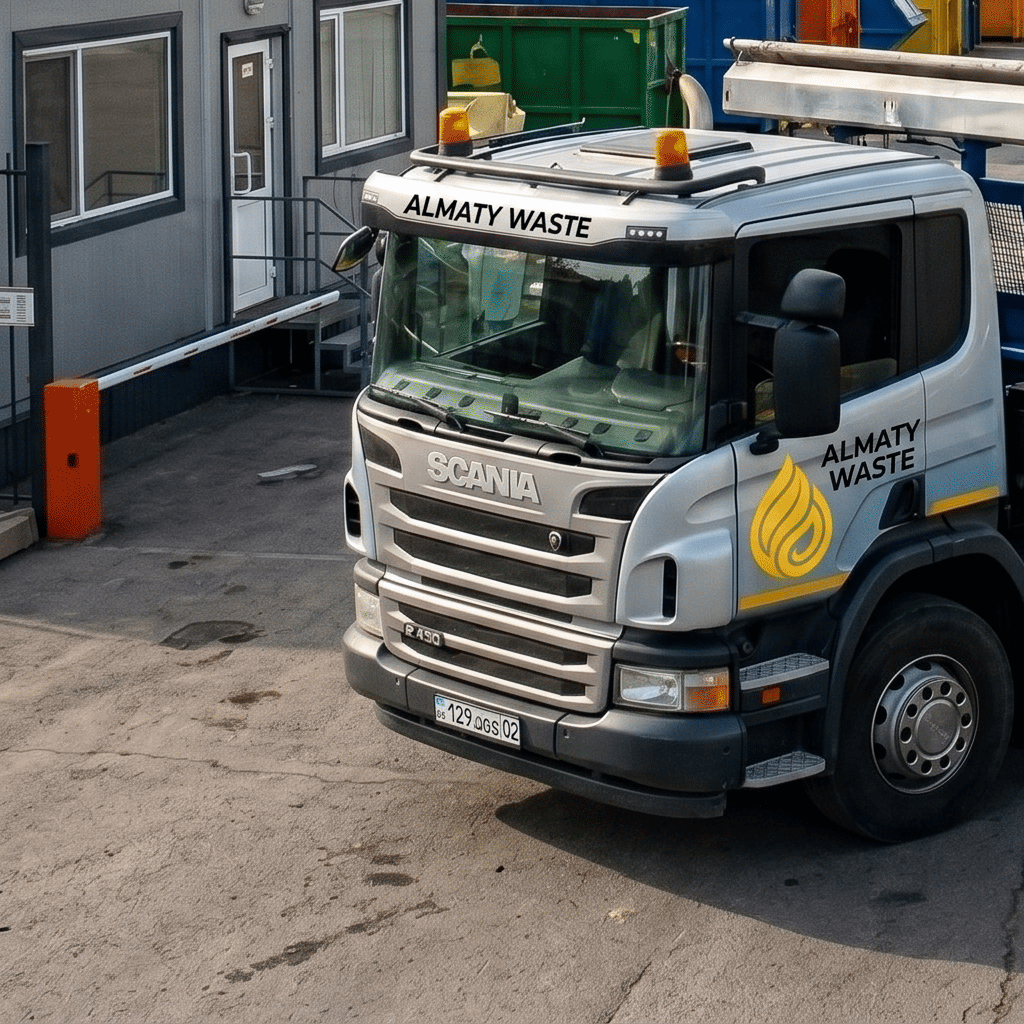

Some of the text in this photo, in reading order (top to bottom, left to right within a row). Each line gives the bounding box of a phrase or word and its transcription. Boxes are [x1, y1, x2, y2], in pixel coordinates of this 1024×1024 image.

[403, 194, 593, 239] ALMATY WASTE
[821, 418, 921, 468] ALMATY
[427, 451, 542, 505] SCANIA
[829, 447, 915, 492] WASTE
[447, 703, 473, 727] 129
